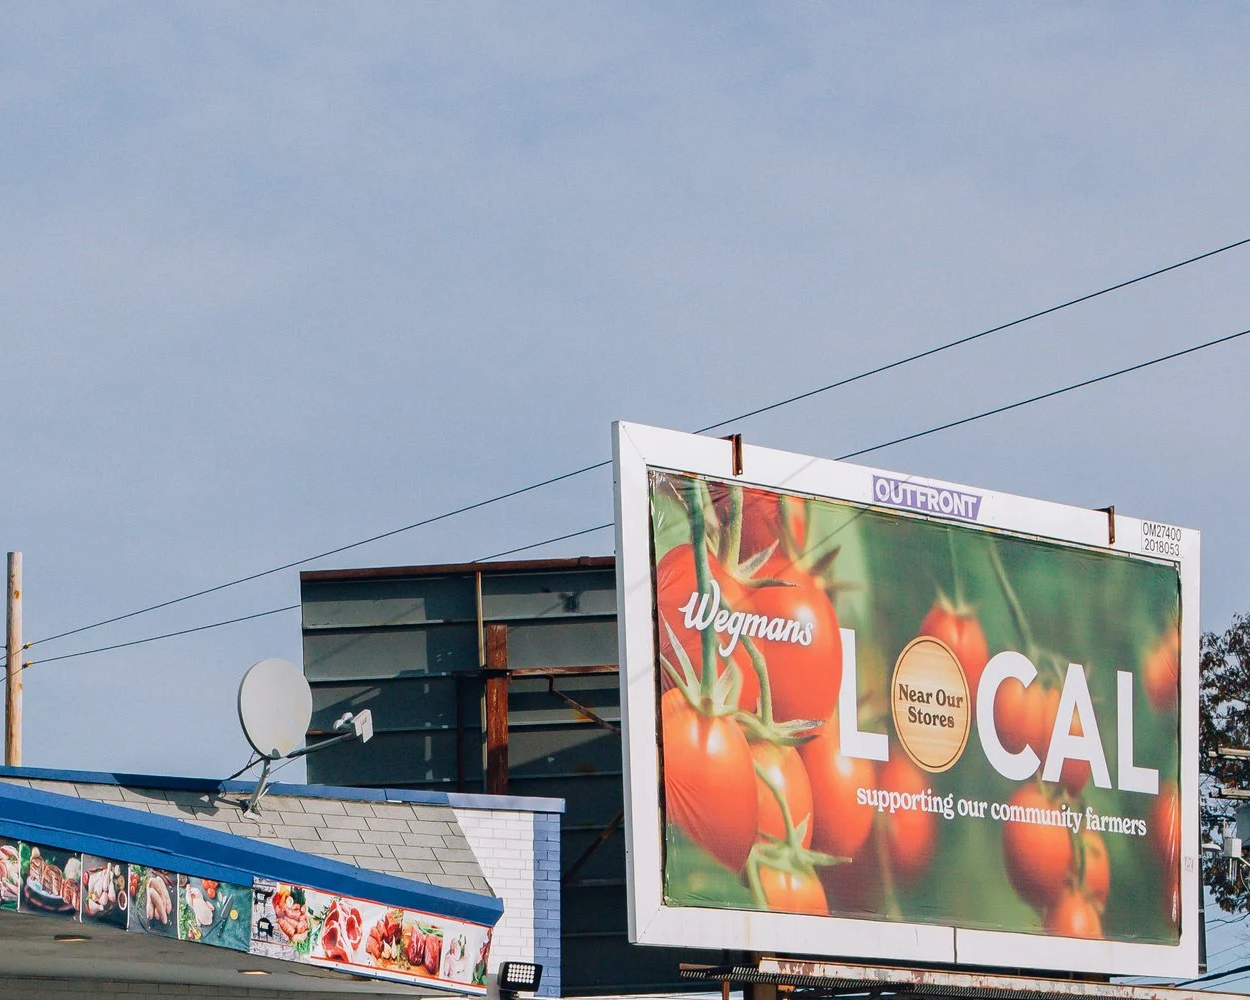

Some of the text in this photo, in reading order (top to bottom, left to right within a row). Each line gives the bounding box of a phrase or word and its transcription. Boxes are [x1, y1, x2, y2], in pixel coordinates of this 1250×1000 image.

[875, 478, 978, 519] OUTFRONT
[1142, 522, 1182, 542] OM27400
[1144, 538, 1180, 556] 2018053
[678, 579, 814, 657] Wegmans
[899, 683, 964, 709] Near Our
[907, 706, 955, 729] Stores
[856, 786, 1147, 836] supporting our community farmers
